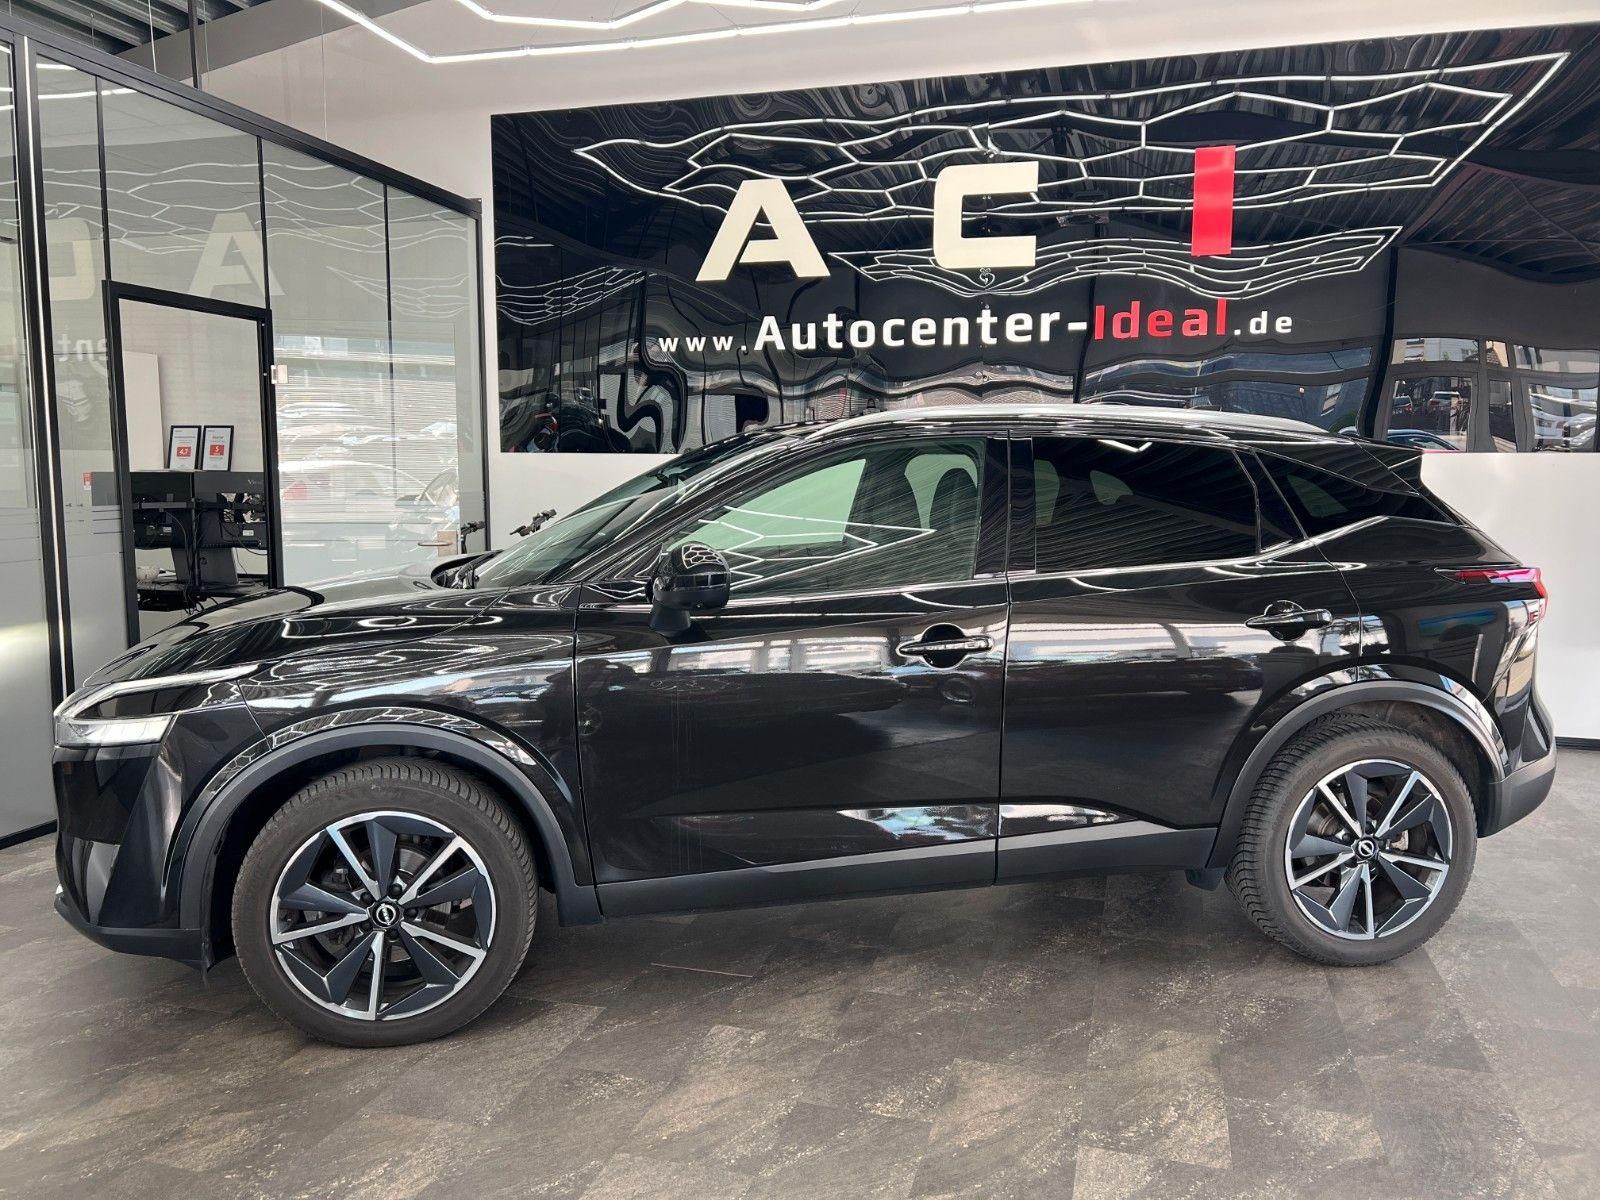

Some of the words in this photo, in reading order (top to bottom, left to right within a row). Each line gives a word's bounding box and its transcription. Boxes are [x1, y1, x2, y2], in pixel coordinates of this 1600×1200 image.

[696, 178, 830, 281] A
[932, 161, 1039, 270] C
[1190, 145, 1236, 257] I
[658, 297, 1293, 352] www.Autocenter-Ideal.de
